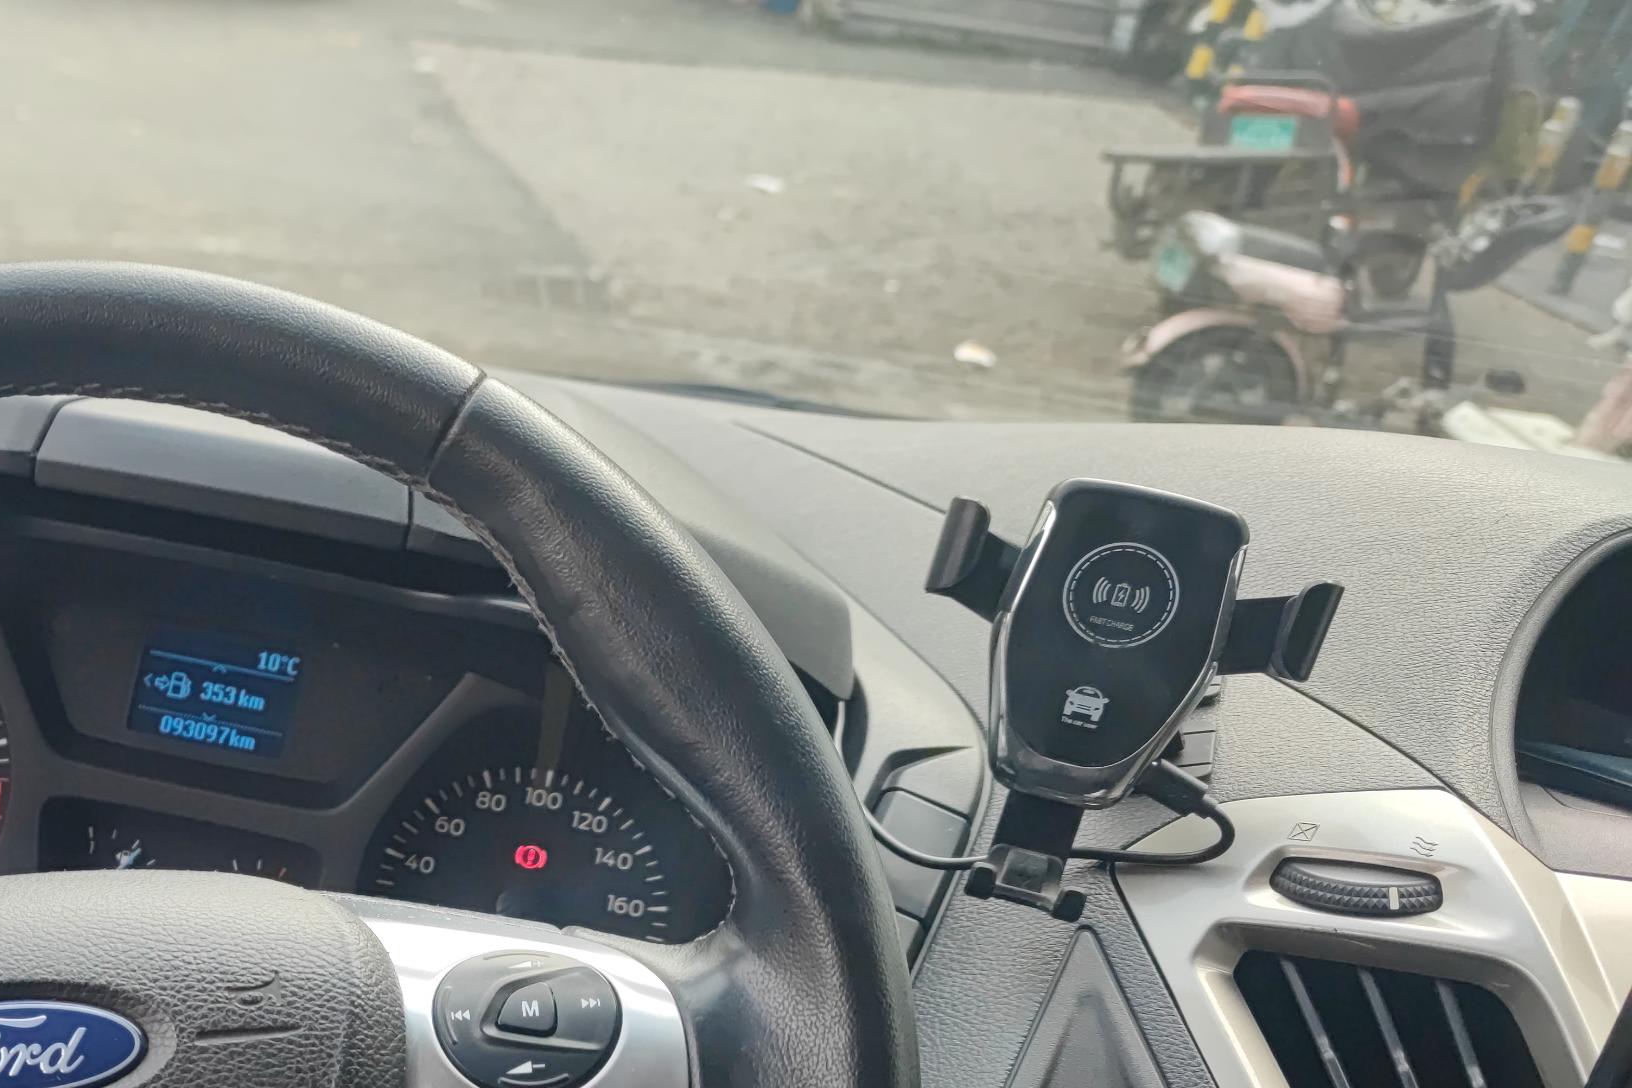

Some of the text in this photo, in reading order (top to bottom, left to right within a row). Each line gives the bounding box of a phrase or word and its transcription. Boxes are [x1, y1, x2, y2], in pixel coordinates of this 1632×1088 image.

[200, 681, 266, 712] 353 km
[475, 791, 507, 812] 80
[524, 787, 563, 810] 100
[434, 816, 466, 837] 60
[571, 810, 608, 834] 120
[404, 854, 435, 875] 40
[594, 847, 634, 871] 140
[607, 894, 646, 918] 160
[521, 1000, 540, 1017] M
